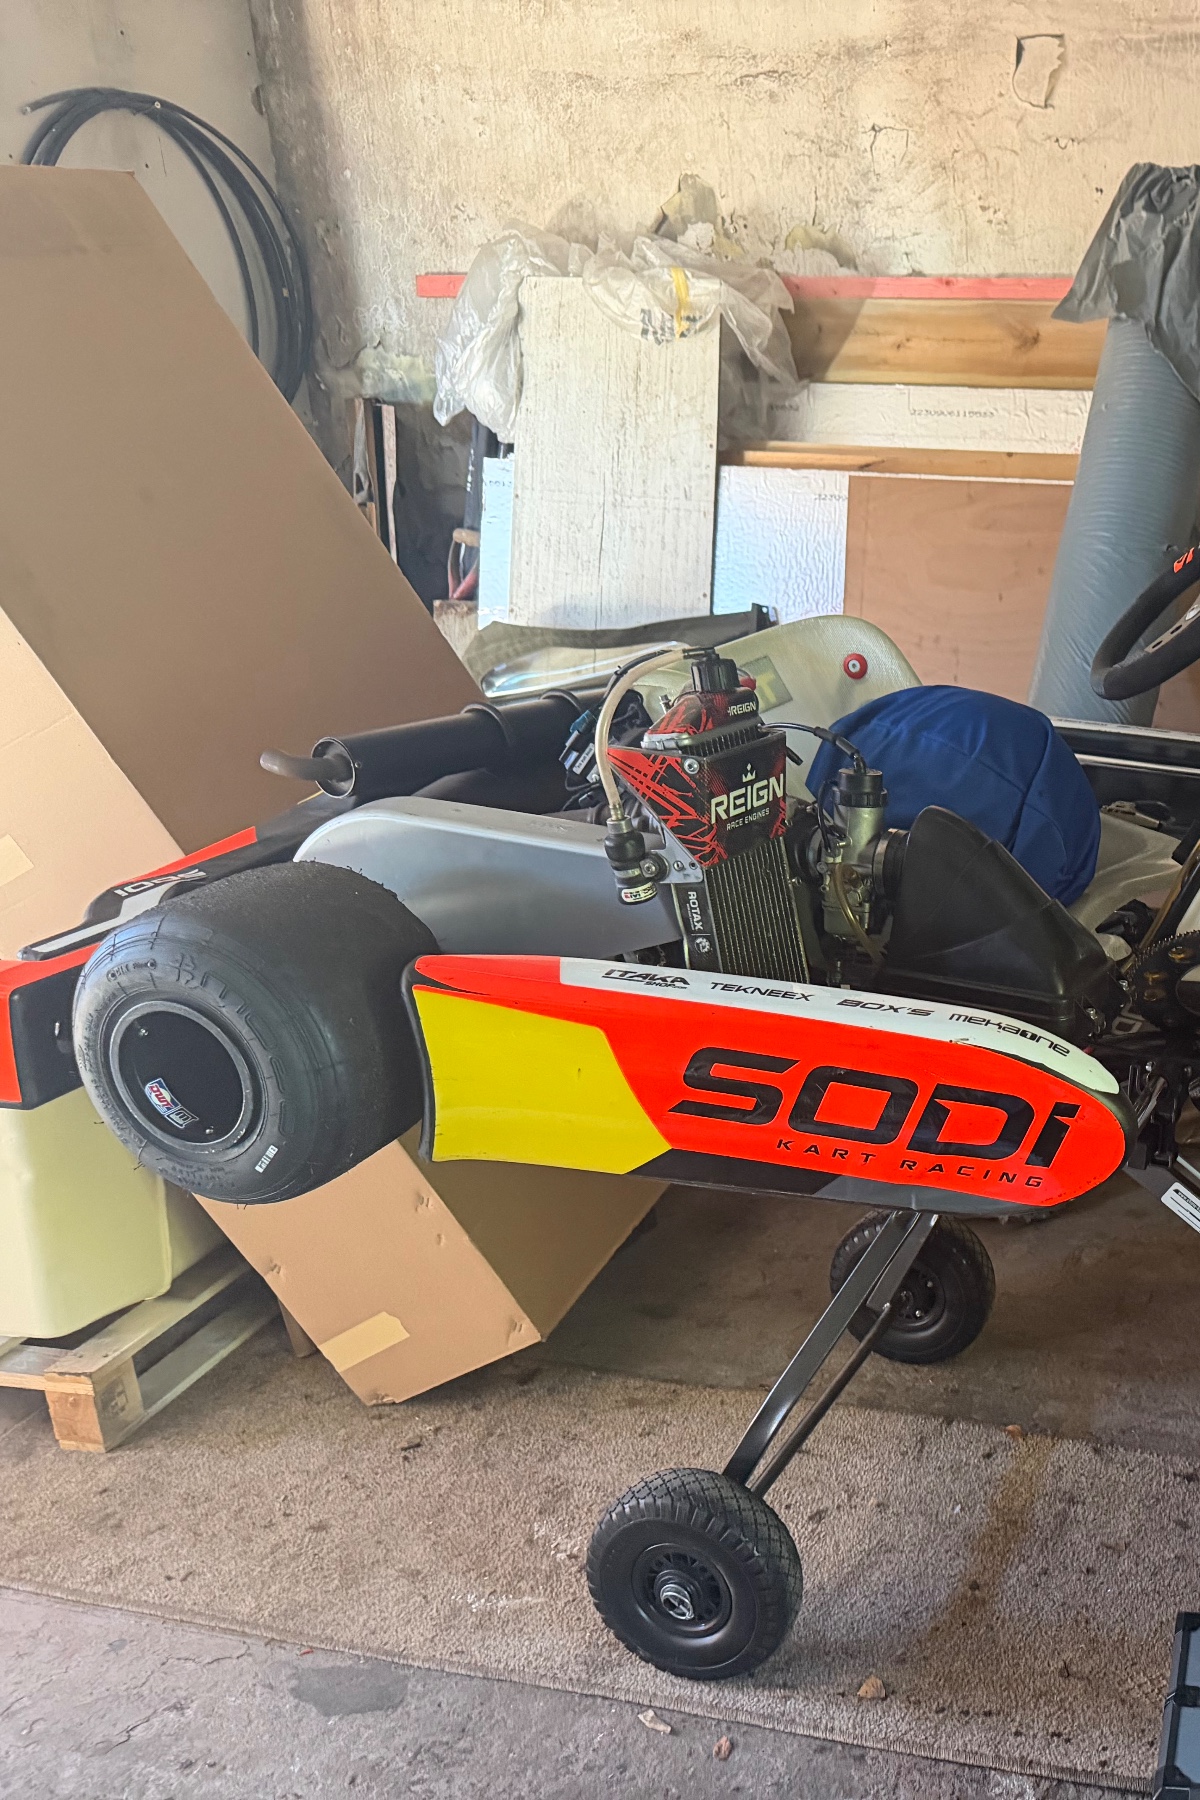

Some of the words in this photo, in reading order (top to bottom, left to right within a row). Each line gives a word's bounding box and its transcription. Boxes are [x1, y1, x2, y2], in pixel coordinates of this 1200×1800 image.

[731, 701, 756, 717] REIGN
[710, 773, 784, 825] REIGN
[726, 818, 744, 831] RACE
[744, 807, 770, 824] ENGINES
[687, 891, 704, 931] ROTAX
[603, 968, 690, 986] ITAKA
[710, 982, 815, 1001] TEKNEEX
[836, 998, 935, 1018] BOX'S
[776, 1138, 876, 1165] KART
[900, 1159, 1044, 1188] RACING
